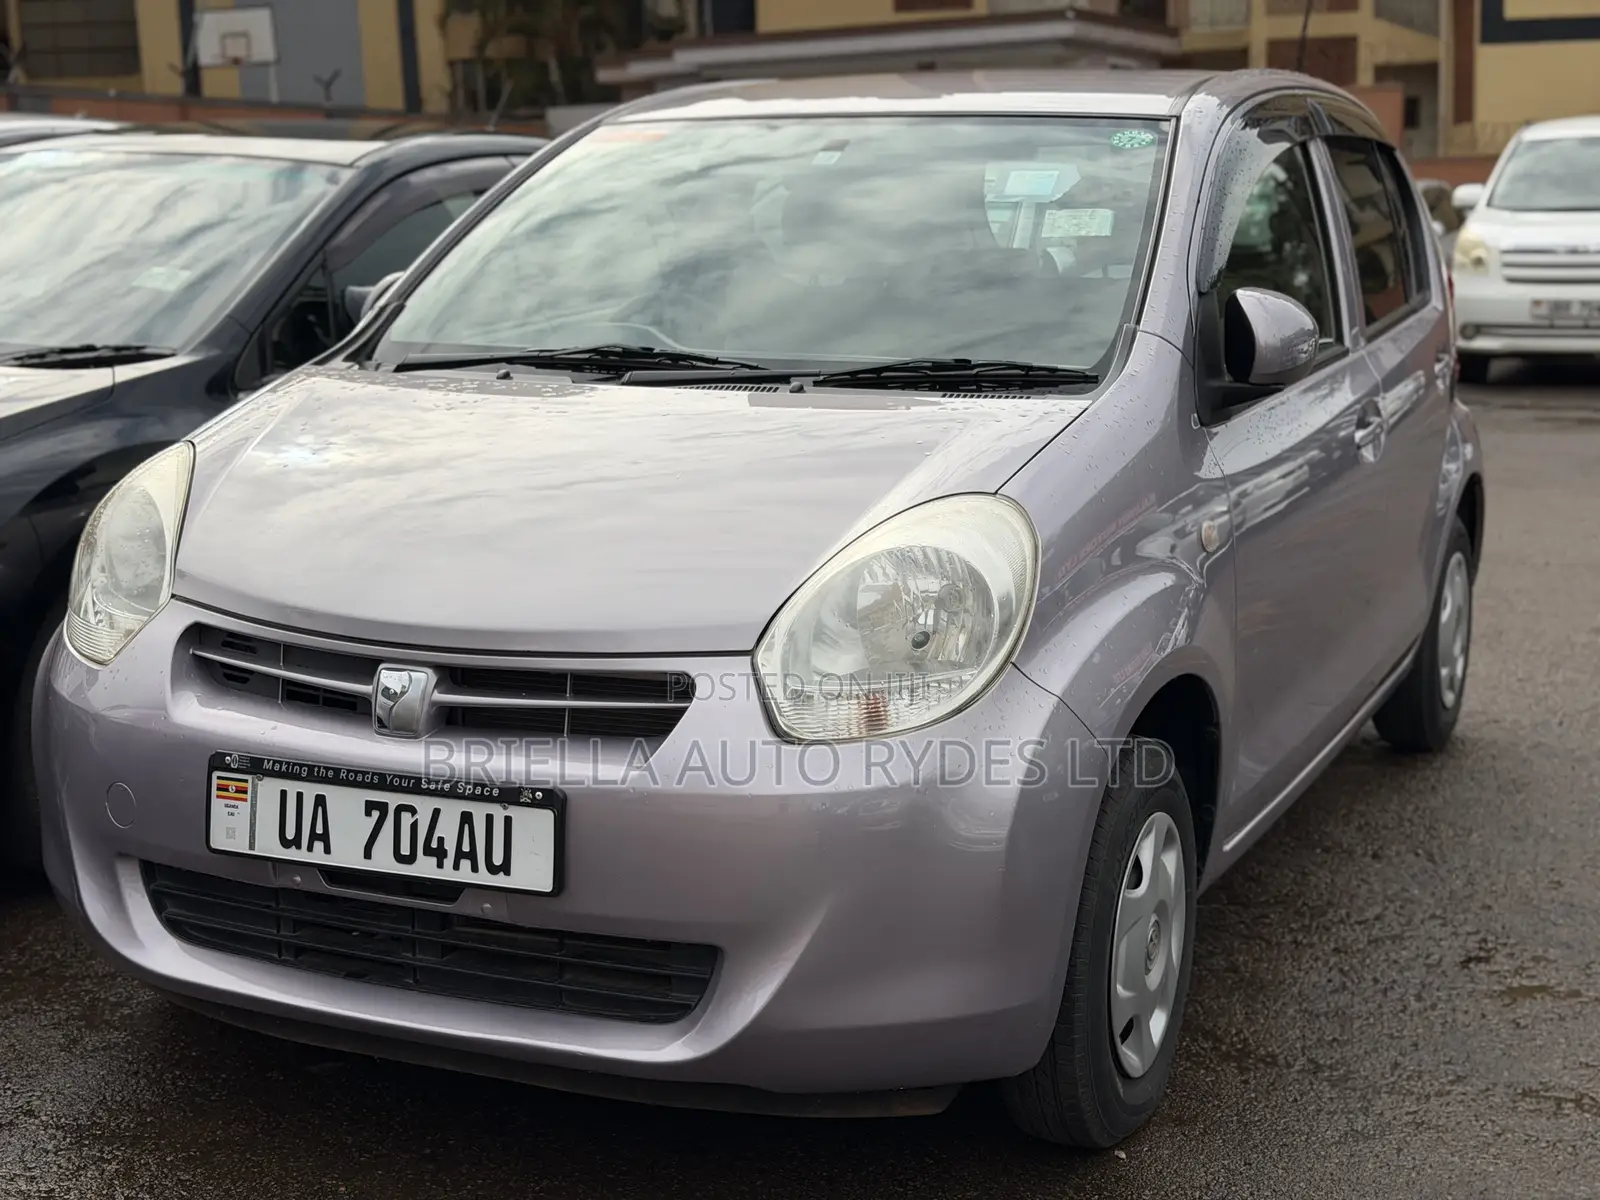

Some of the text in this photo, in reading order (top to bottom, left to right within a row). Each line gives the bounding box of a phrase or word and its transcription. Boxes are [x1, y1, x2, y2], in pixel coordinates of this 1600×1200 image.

[262, 759, 309, 778] Making
[313, 766, 334, 778] the
[339, 769, 380, 784] Roads
[385, 774, 416, 788] Your
[420, 778, 451, 792] Safe
[456, 781, 500, 797] Space
[278, 788, 513, 877] UA 704AU
